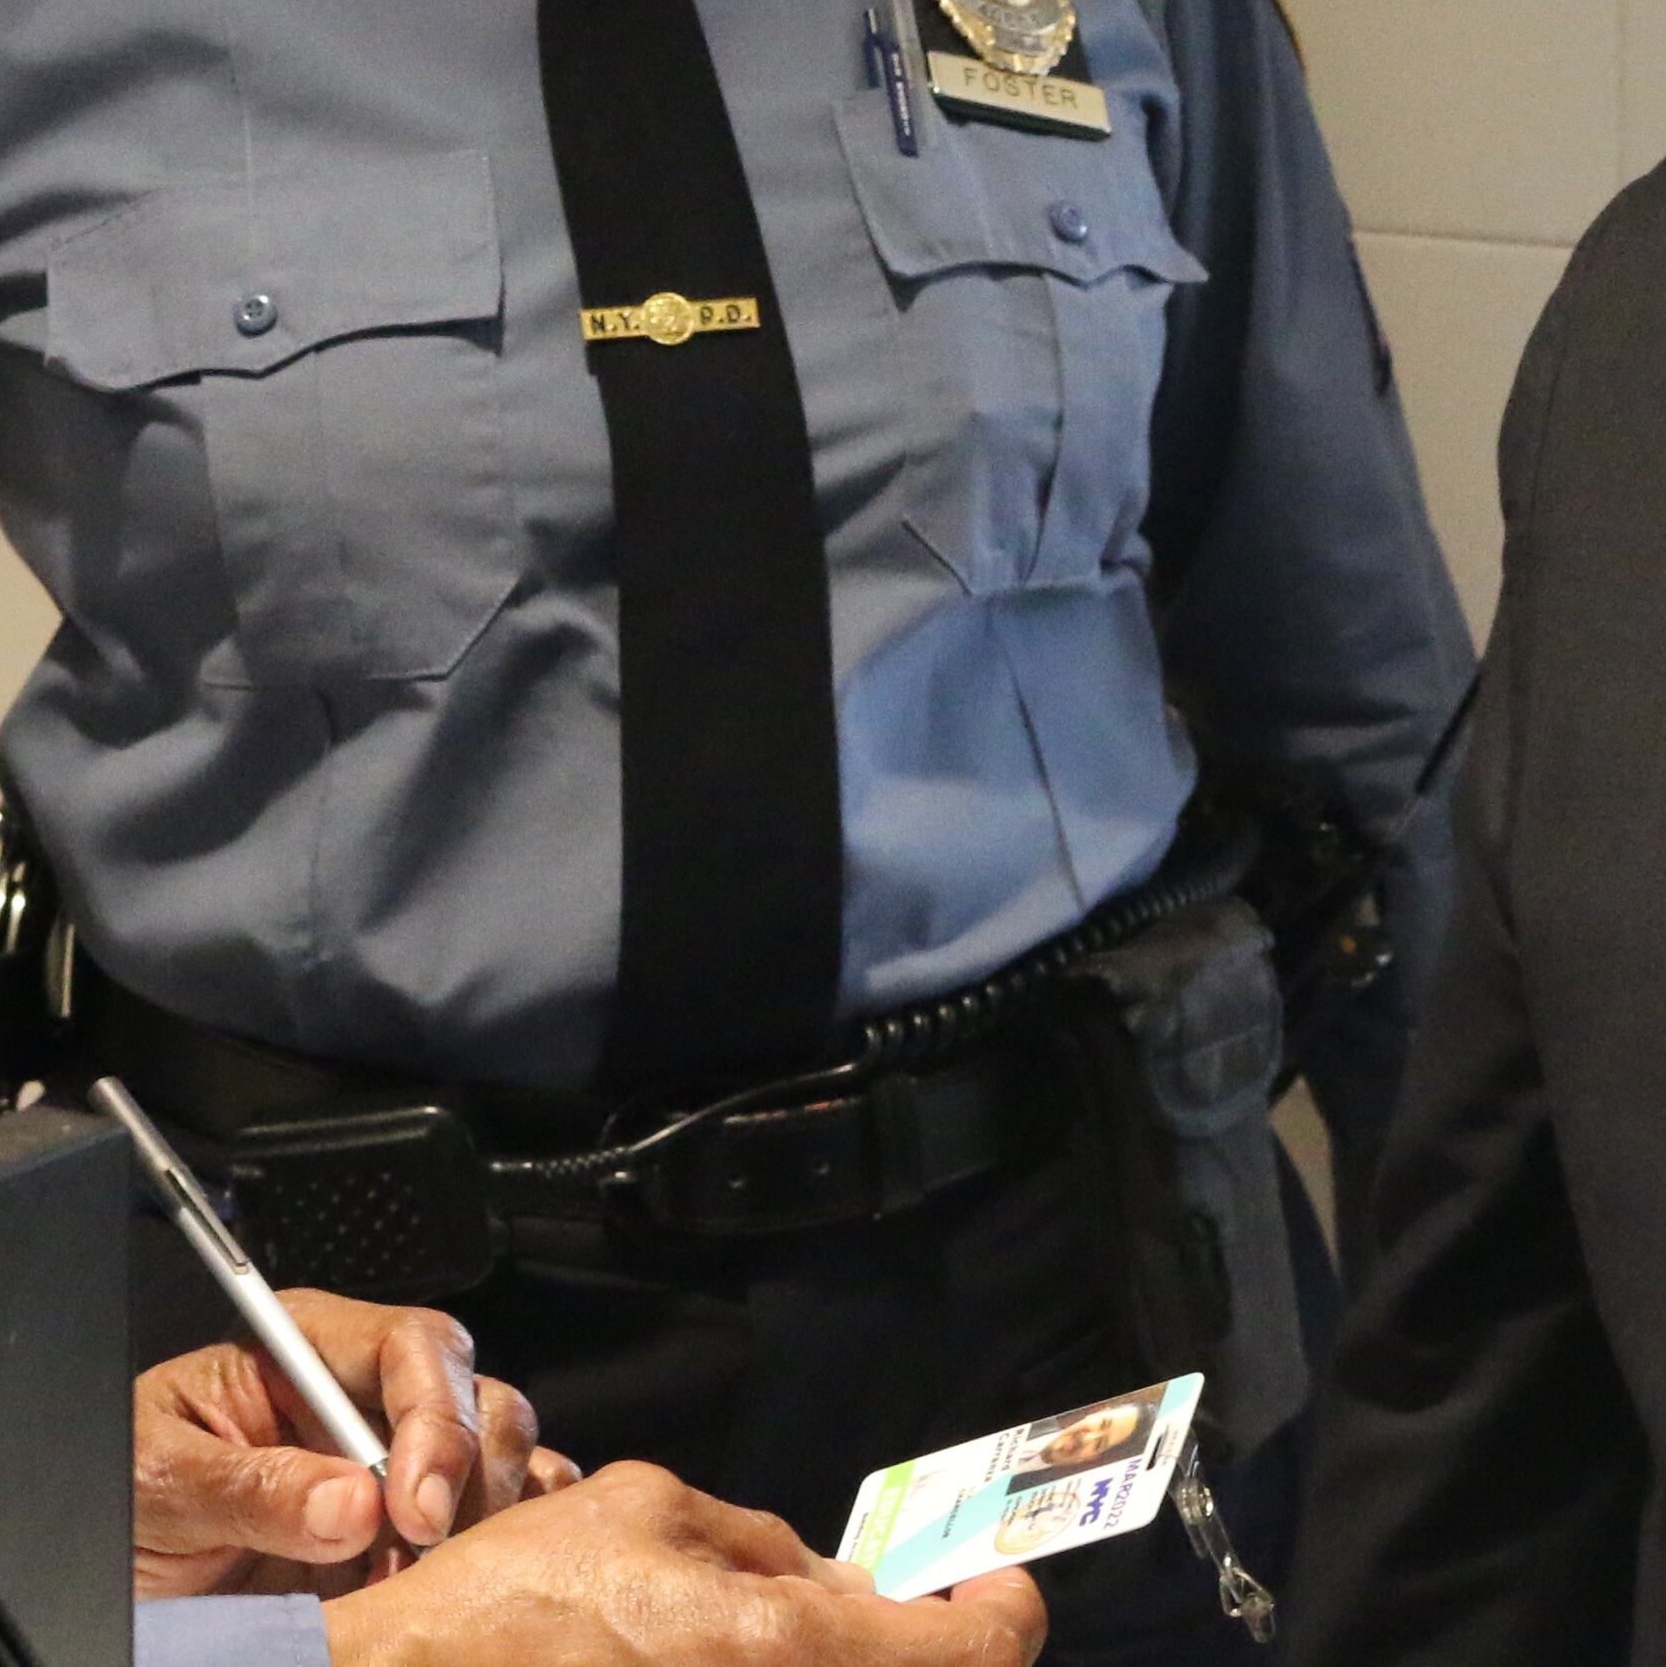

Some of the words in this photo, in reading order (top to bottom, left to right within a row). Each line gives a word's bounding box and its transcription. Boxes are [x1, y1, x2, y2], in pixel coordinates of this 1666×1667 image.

[962, 67, 1079, 109] FOSTER
[590, 312, 641, 335] N.Y.
[1078, 1476, 1114, 1527] NYC
